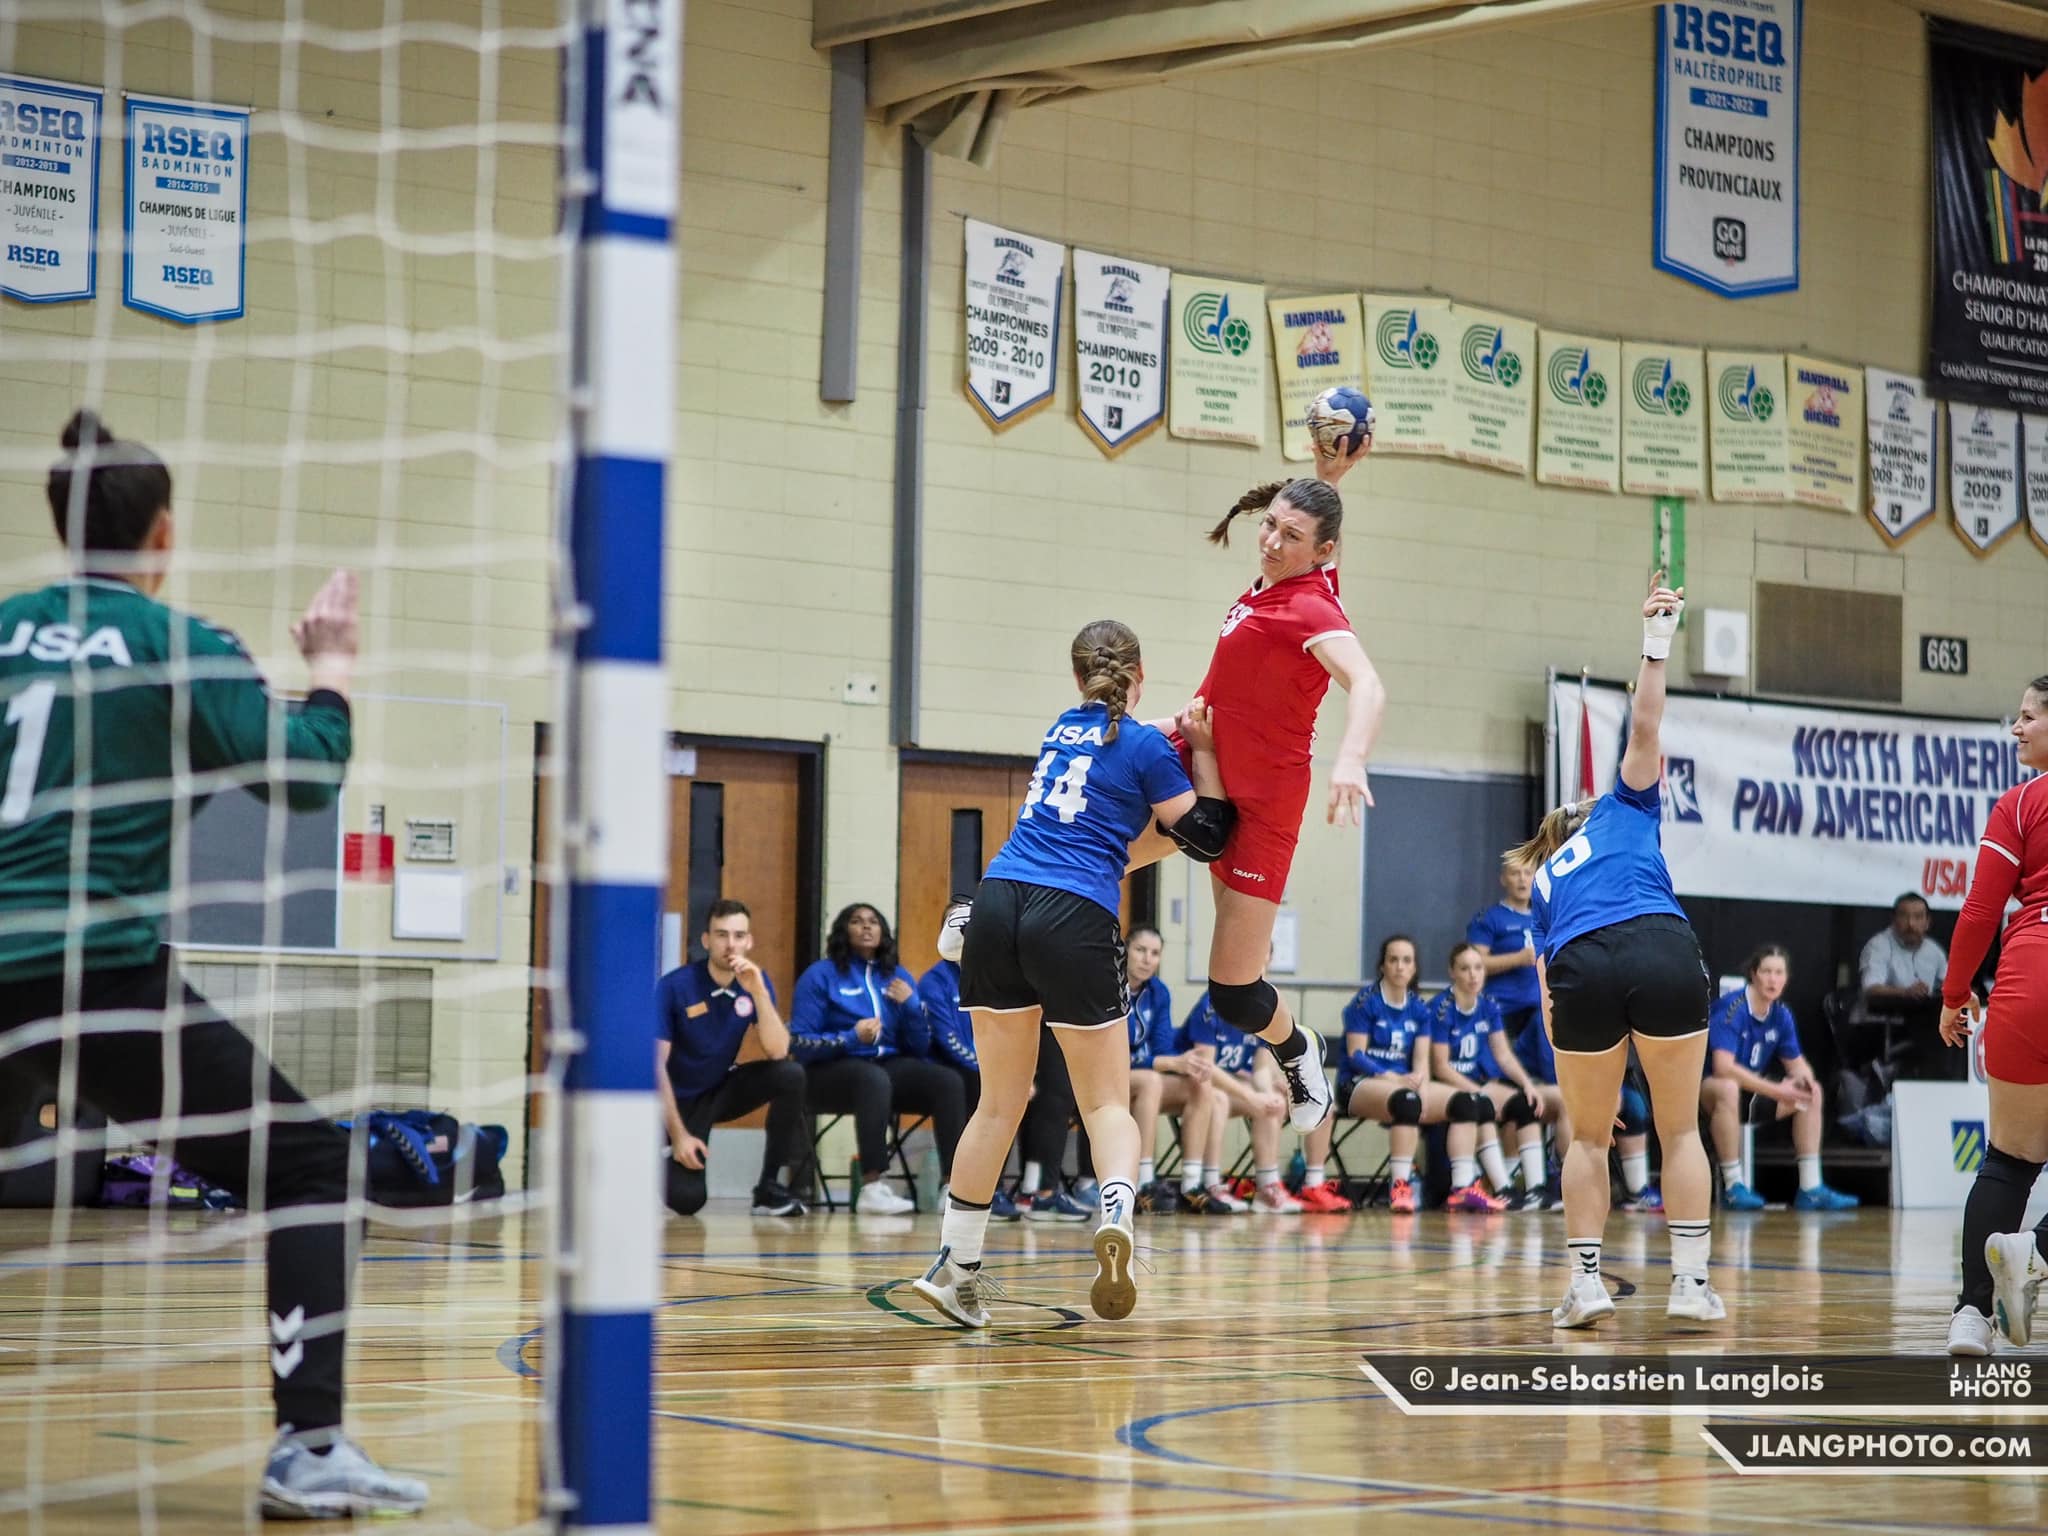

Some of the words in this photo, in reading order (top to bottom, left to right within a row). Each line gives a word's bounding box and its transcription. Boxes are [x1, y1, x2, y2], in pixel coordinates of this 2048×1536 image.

[1673, 3, 1786, 67] RSEQ
[1674, 57, 1783, 93] HALTÉROPHILIE
[142, 122, 234, 162] RSEQ
[1684, 127, 1775, 162] CHAMPIONS
[142, 157, 232, 178] BADMINTON
[1679, 164, 1782, 201] PROVINCIAUX
[139, 200, 193, 218] CHAMPIONS
[194, 207, 206, 220] DE
[208, 208, 236, 222] LIGUE
[1717, 222, 1742, 243] GO
[8, 244, 61, 267] RSEQ
[162, 264, 214, 285] RSEQ
[967, 304, 1048, 339] CHAMPIONNES
[1284, 309, 1345, 328] HANDBALL
[984, 325, 1028, 346] SAISON
[1011, 345, 1044, 369] 2010
[1077, 339, 1157, 368] CHAMPIONNES
[1090, 362, 1141, 389] 2010
[1798, 369, 1850, 394] HANDBALL
[1940, 361, 1988, 383] CANADIAN
[1871, 466, 1892, 485] 009
[1954, 463, 2013, 481] CHAMPIONNES
[1964, 481, 2001, 500] 2009
[1926, 638, 1962, 672] 663
[1044, 725, 1103, 746] USA
[4, 680, 55, 823] 1
[1792, 726, 1900, 784] NORTH
[1733, 779, 1803, 837] PAN
[1811, 785, 1977, 847] AMERICAN
[1233, 868, 1258, 880] CRAFT
[1922, 858, 1967, 897] USA
[1218, 1045, 1243, 1068] 23
